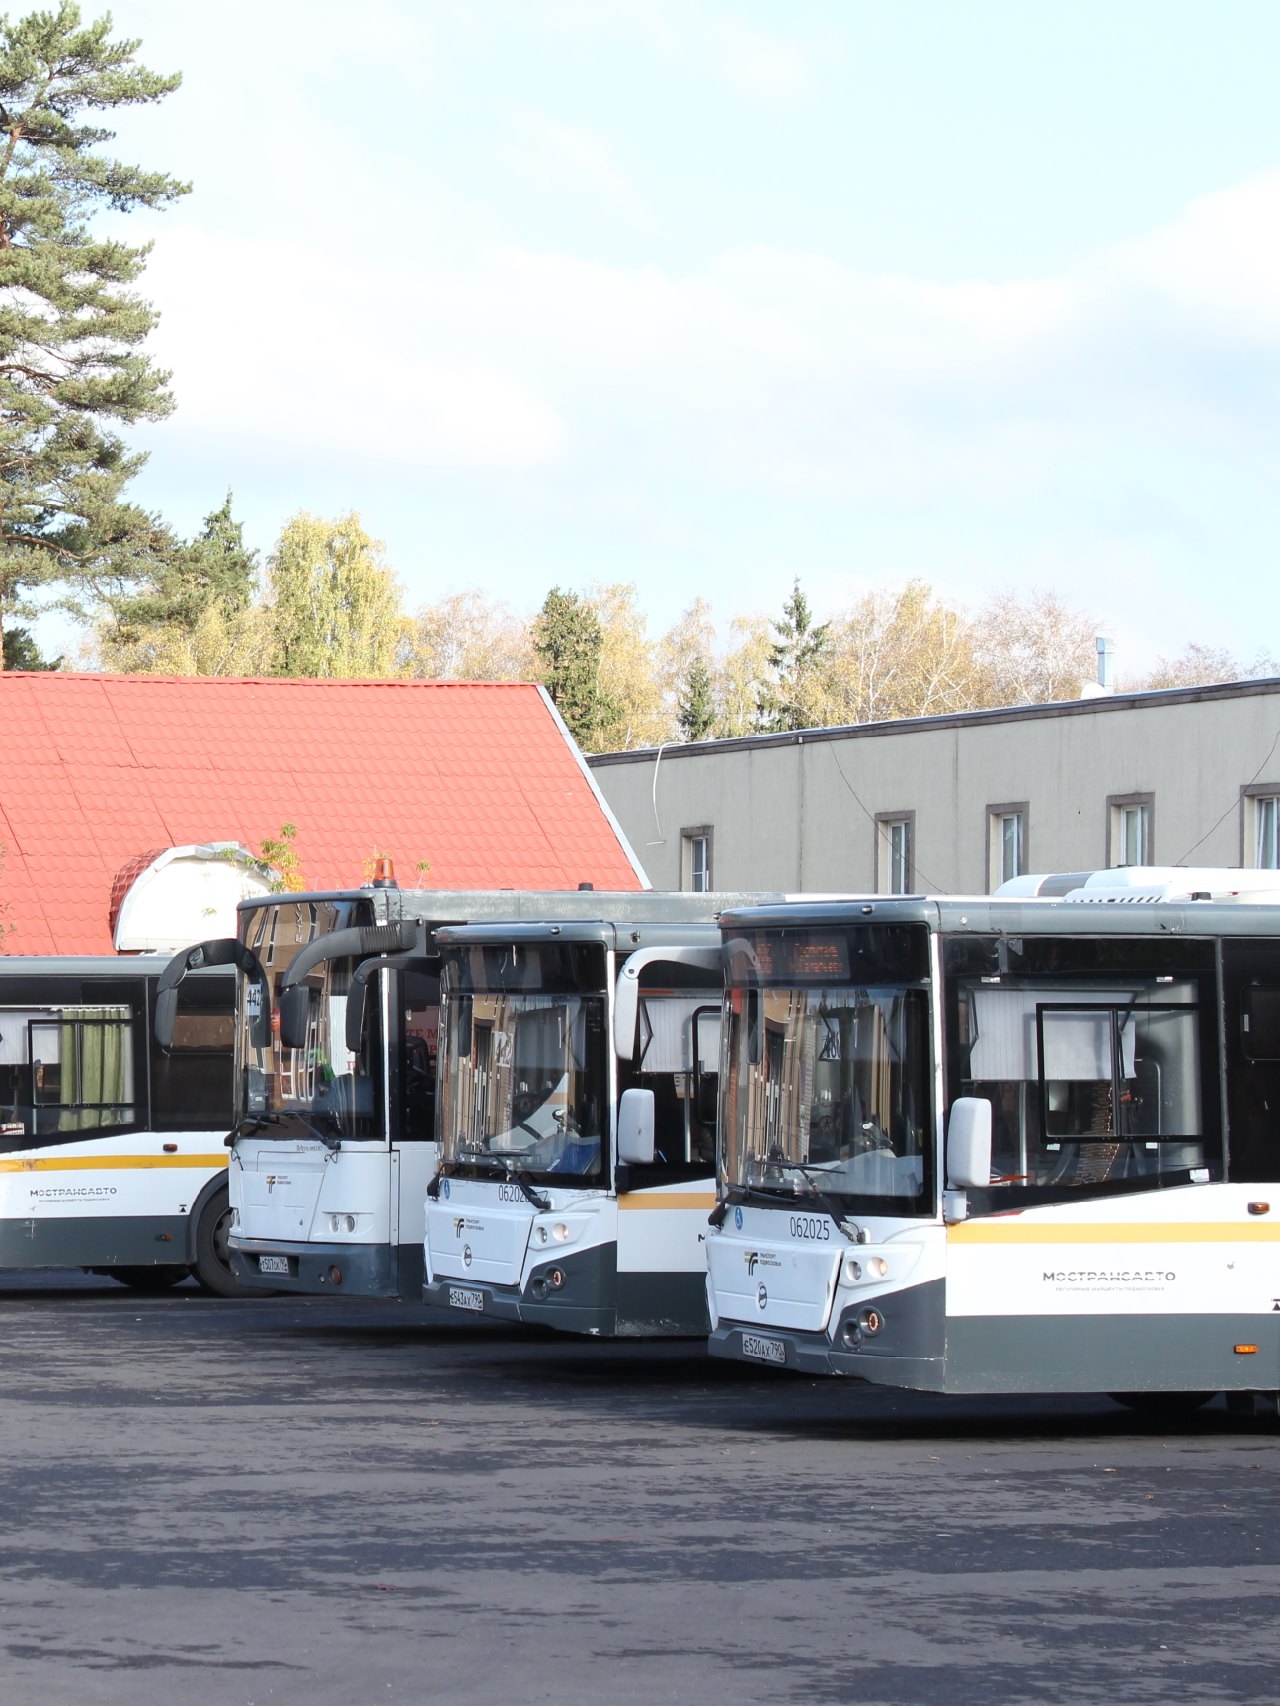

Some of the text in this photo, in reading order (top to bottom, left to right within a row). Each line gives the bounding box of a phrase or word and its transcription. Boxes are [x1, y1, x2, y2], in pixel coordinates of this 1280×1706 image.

[30, 1187, 117, 1197] МОСТРАНСАВТО
[499, 1185, 529, 1202] 06202
[790, 1216, 830, 1241] 062025
[1043, 1271, 1176, 1282] МОСТРАНСАВТО
